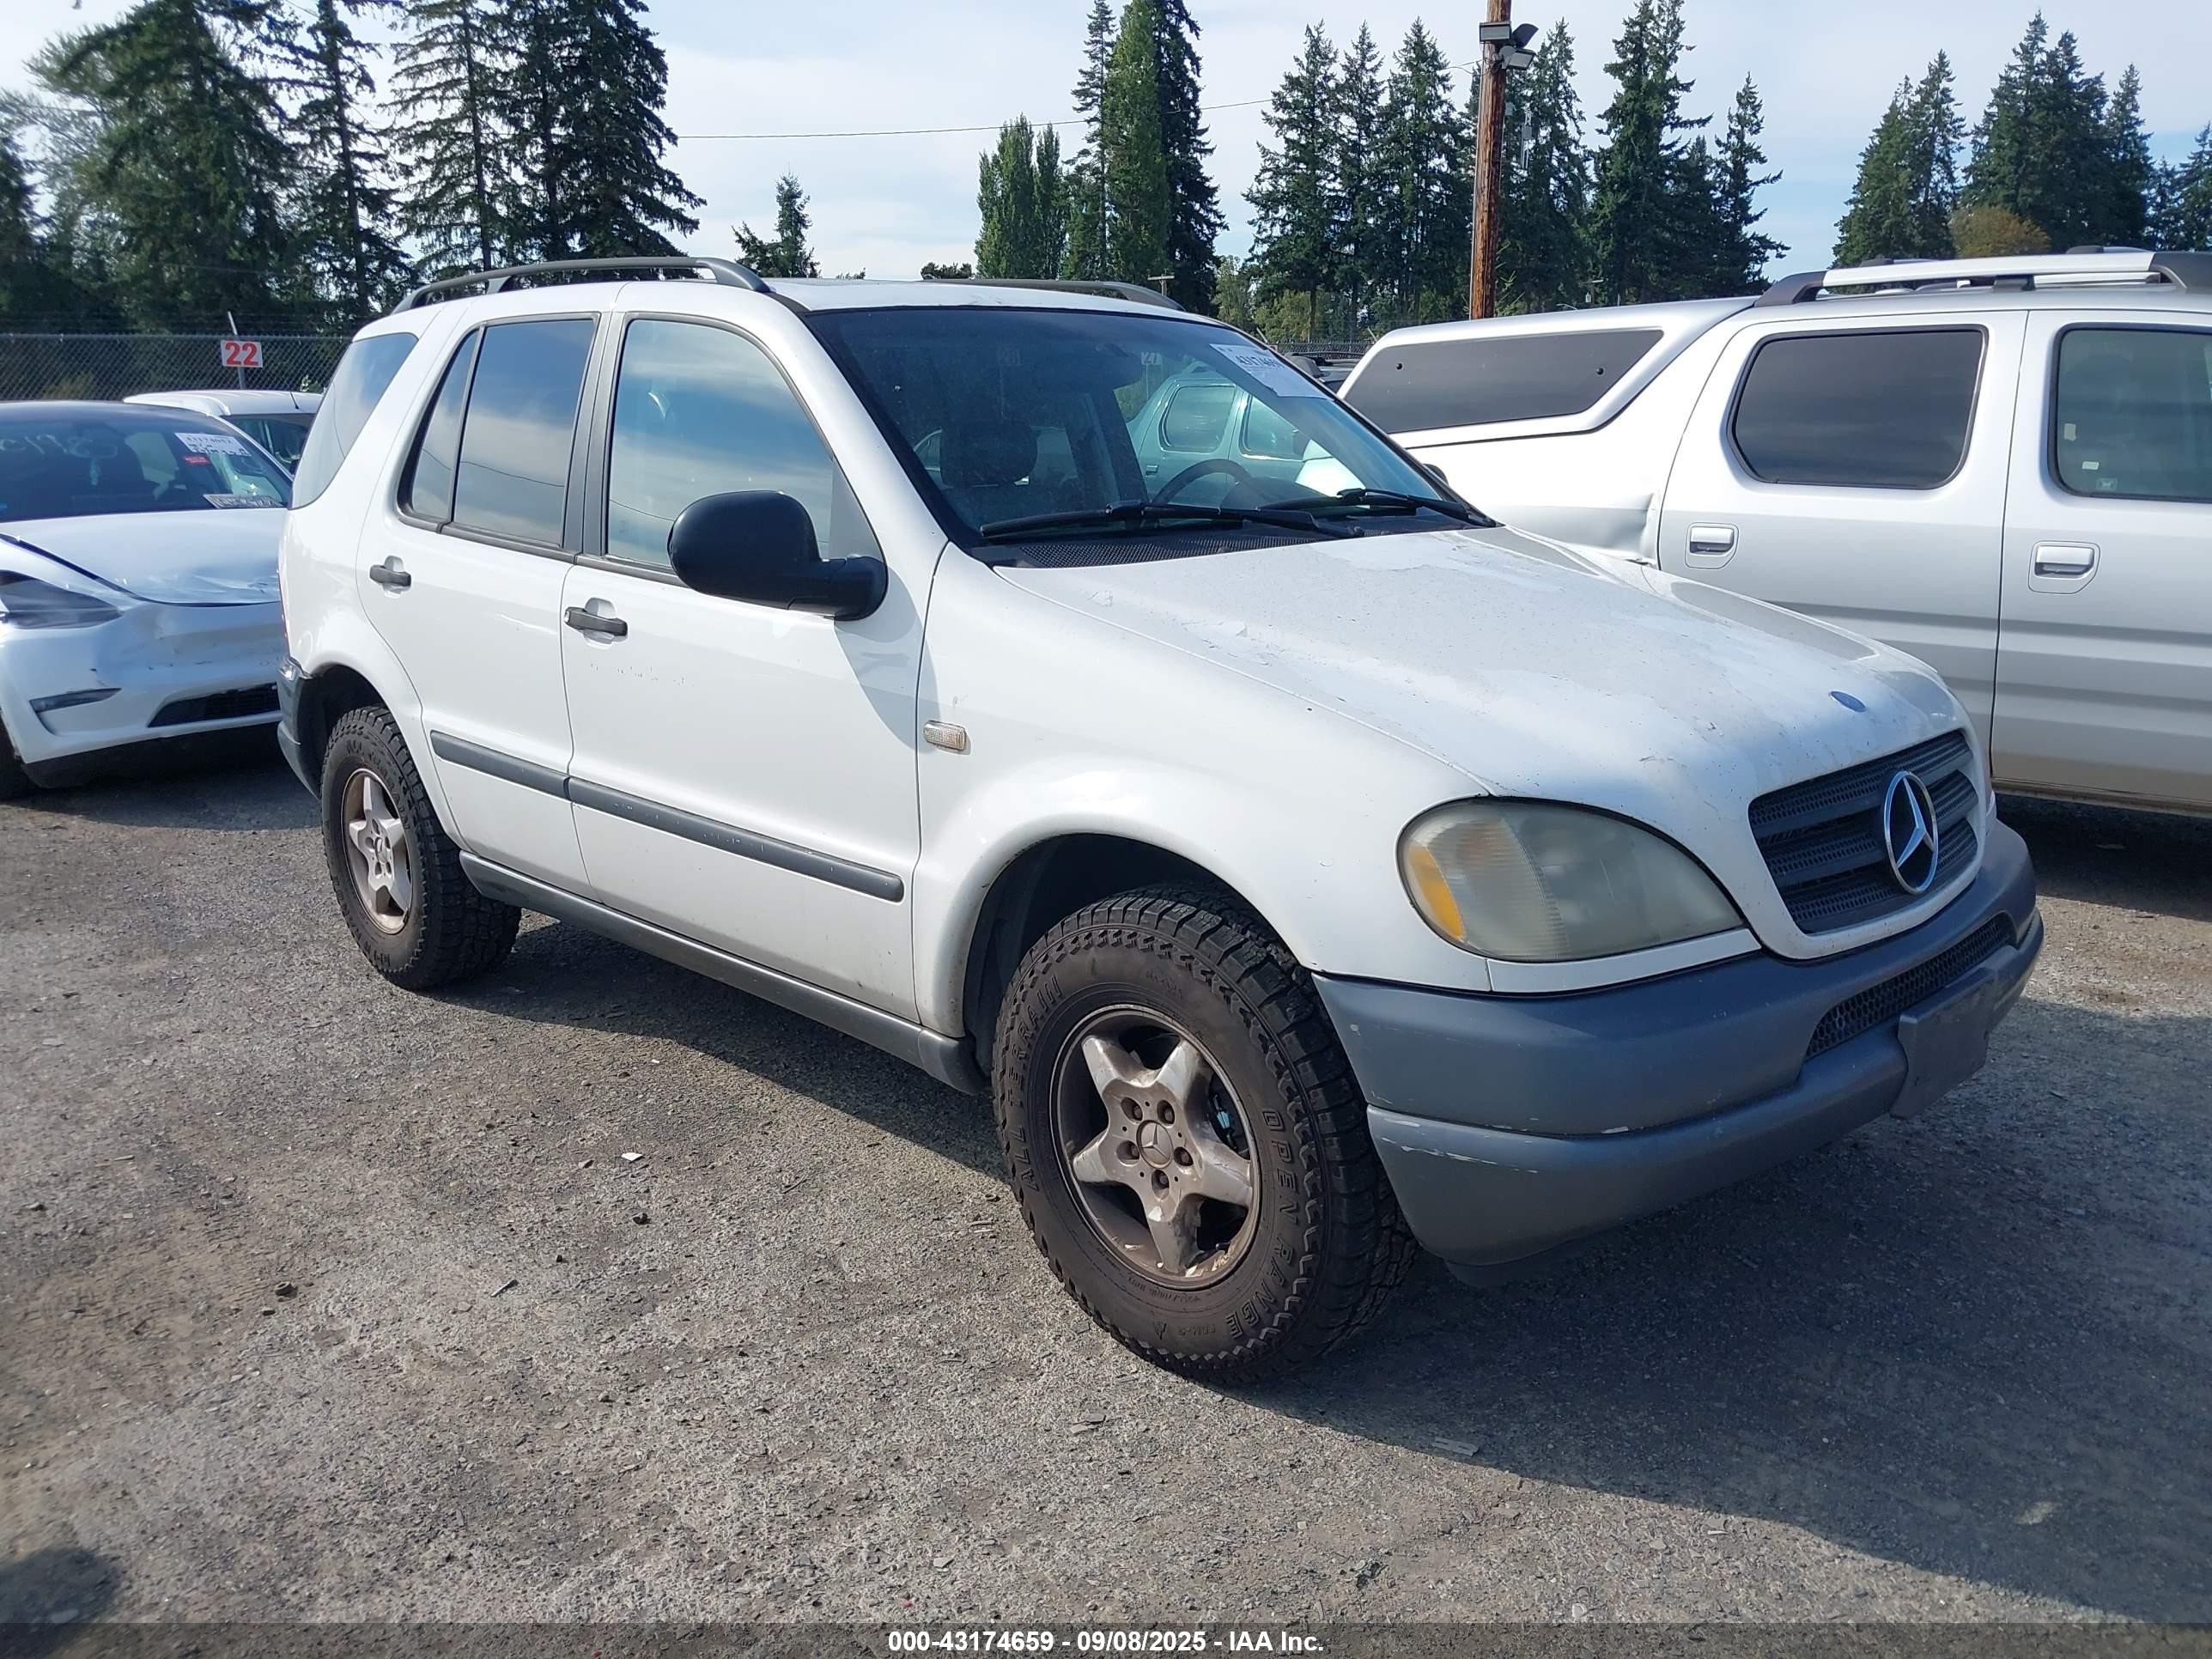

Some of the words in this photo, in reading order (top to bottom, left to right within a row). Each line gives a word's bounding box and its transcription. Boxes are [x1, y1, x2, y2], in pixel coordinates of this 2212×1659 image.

[225, 342, 259, 367] 22
[1007, 974, 1063, 1109] TERRAIN
[1010, 1125, 1040, 1192] ALL
[1262, 1109, 1300, 1226] OPEN
[1225, 1235, 1294, 1340] RANGE
